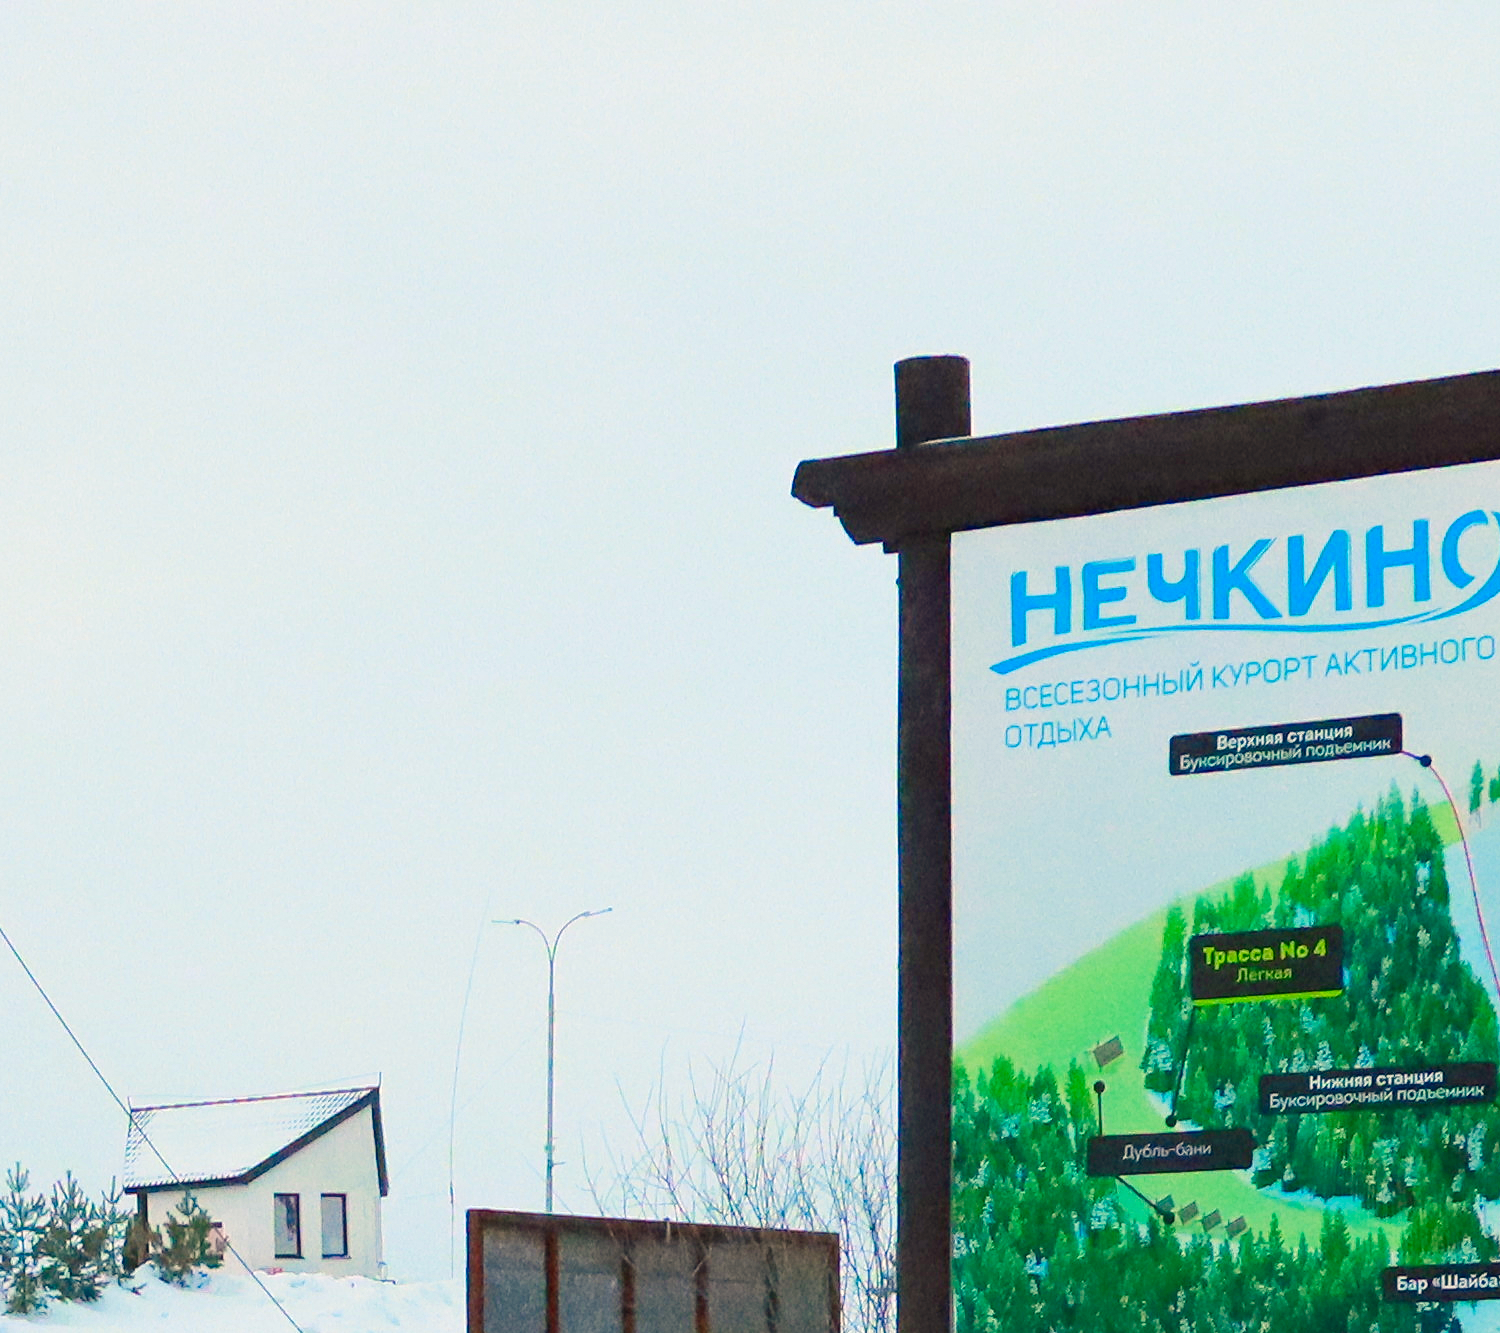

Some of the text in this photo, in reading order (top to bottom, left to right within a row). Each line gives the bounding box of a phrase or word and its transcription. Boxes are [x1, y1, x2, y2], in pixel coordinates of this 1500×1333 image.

[1004, 635, 1496, 713] ВСЕСЕЗОННЫЙ КУРОРТ АКТИВНОГО
[1004, 716, 1112, 750] ОТДЫХА
[1216, 724, 1353, 754] Верхняя станция
[1179, 737, 1391, 772] Буксировочный подъемник
[1203, 946, 1275, 970] Трасса
[1313, 938, 1327, 957] 4
[1308, 1071, 1444, 1092] Нижняя станция
[1269, 1083, 1485, 1111] Буксировочный подъемник
[1122, 1141, 1213, 1162] Дубль-бани
[1396, 1275, 1428, 1294] Бар
